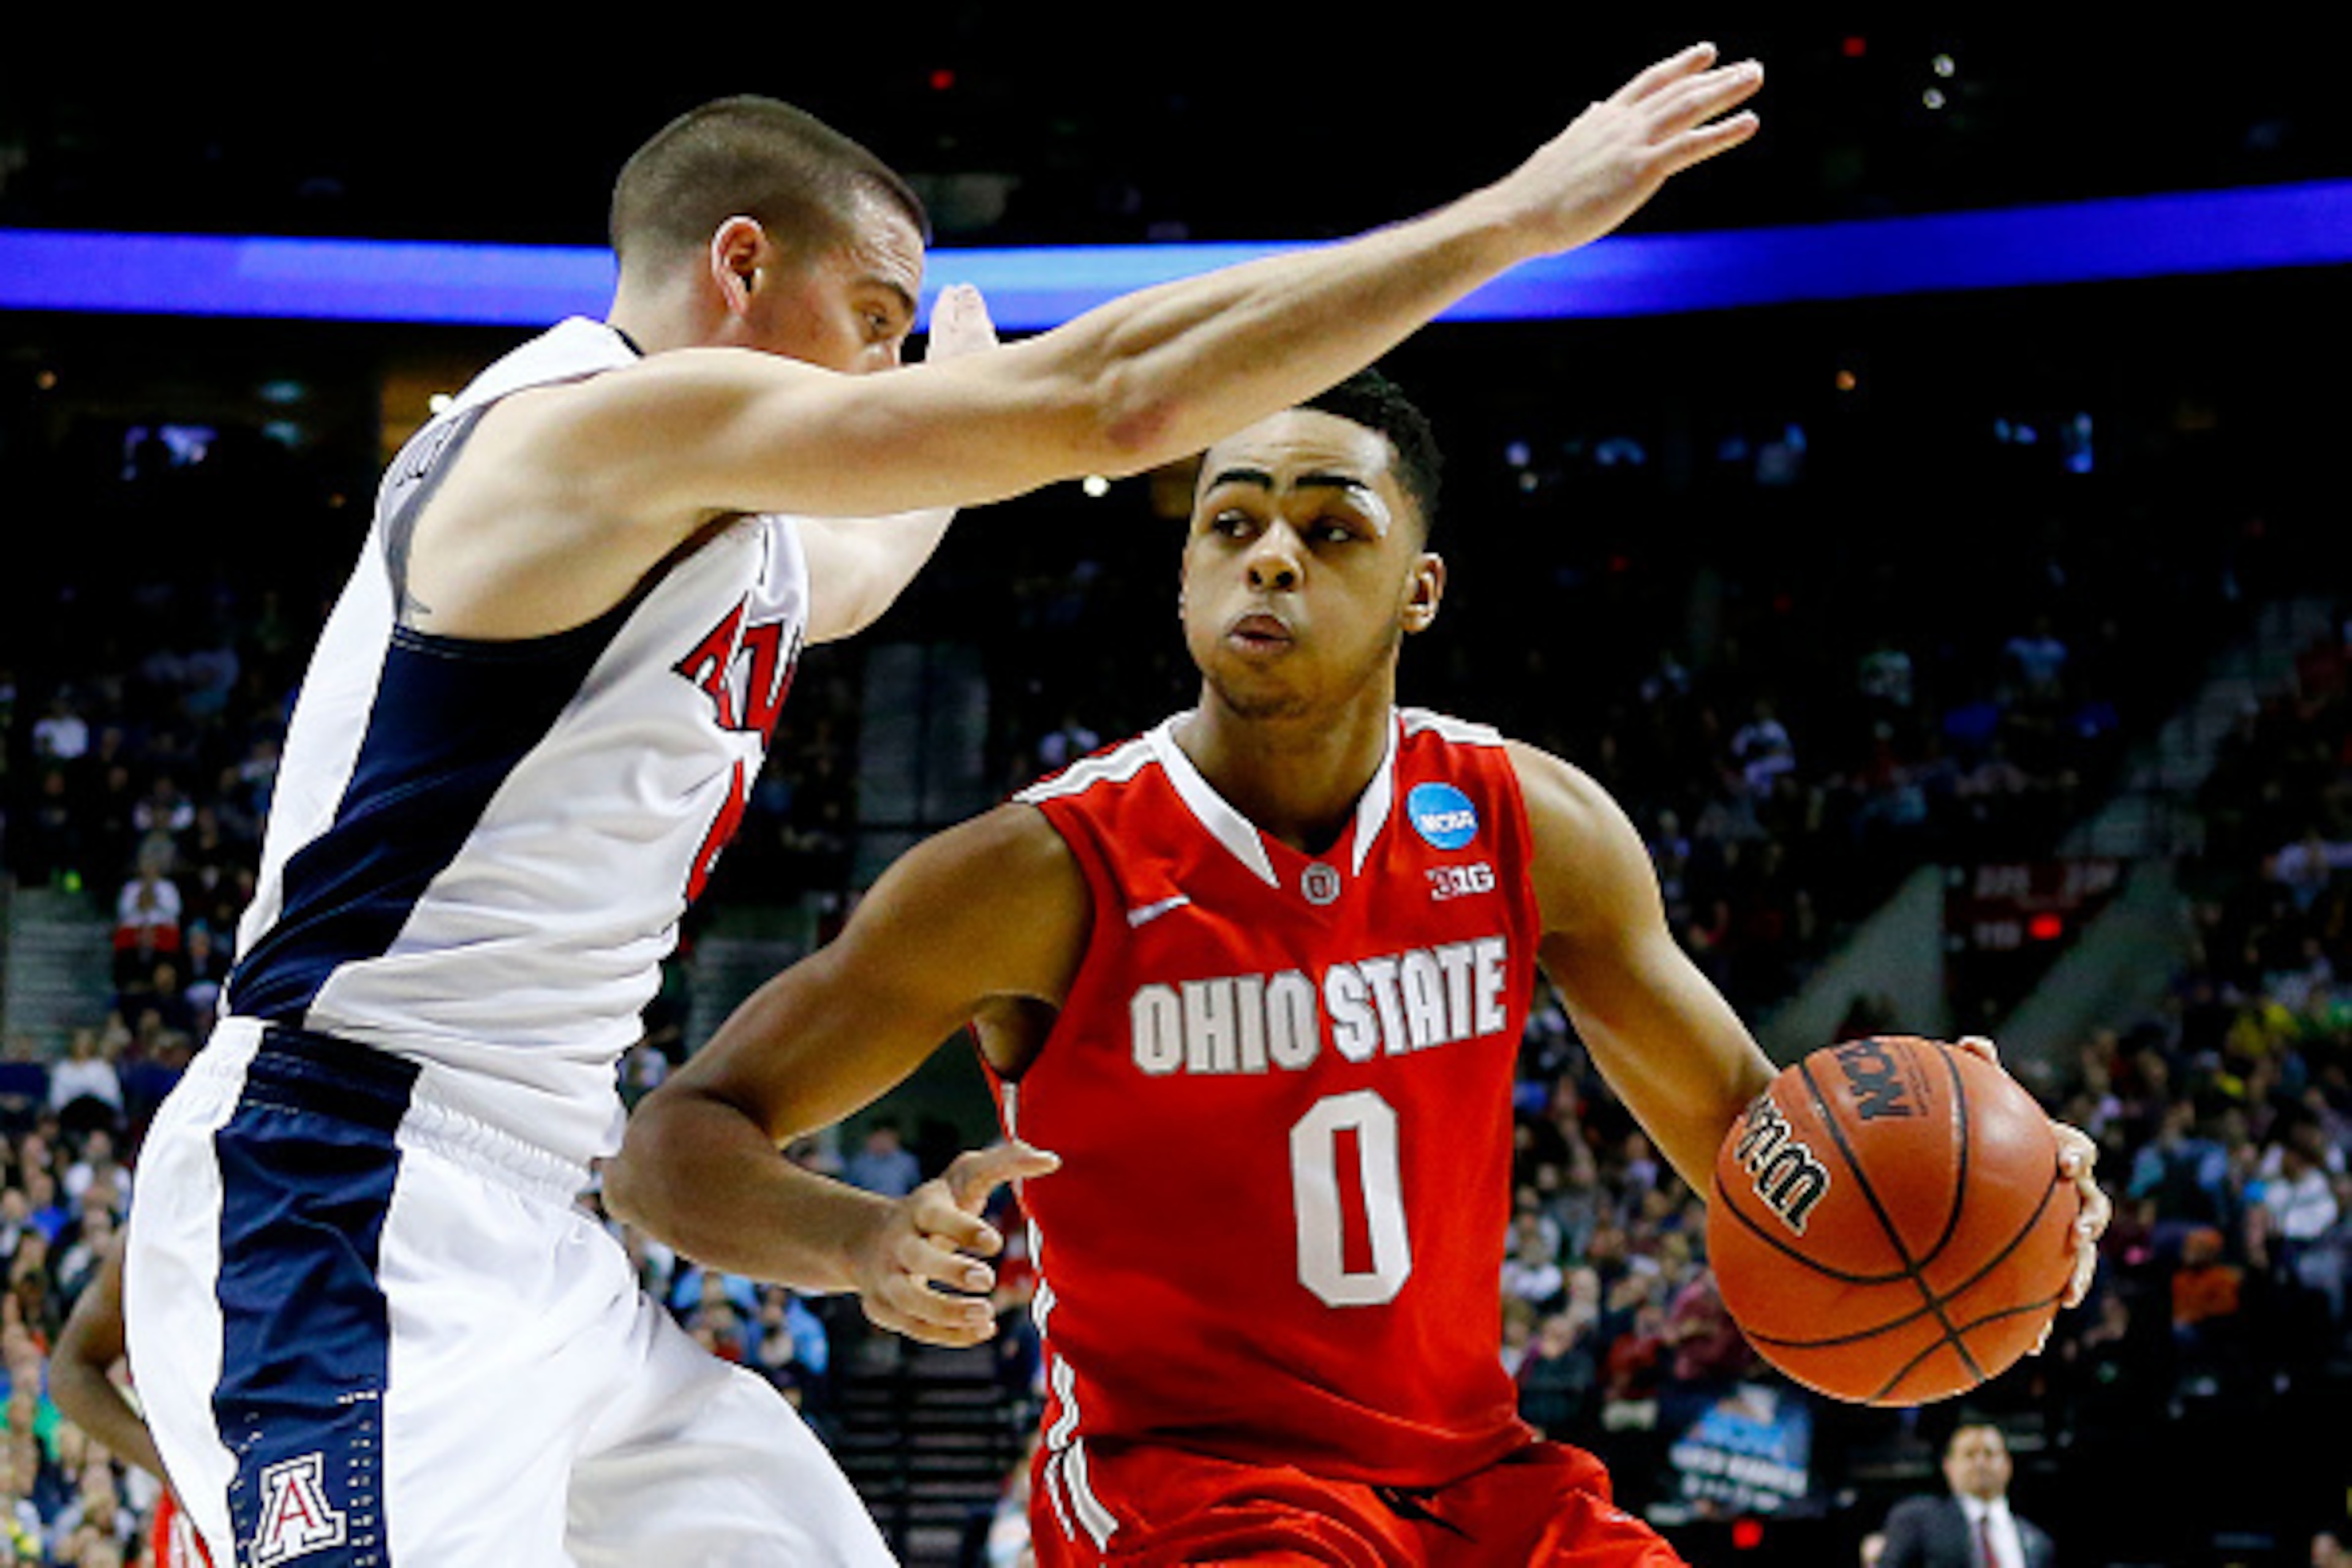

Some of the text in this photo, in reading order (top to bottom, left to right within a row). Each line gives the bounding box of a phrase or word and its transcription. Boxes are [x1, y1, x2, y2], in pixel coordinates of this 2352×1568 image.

[1130, 935, 1507, 1076] OHIO STATE
[1289, 1088, 1412, 1308] 0
[249, 1450, 347, 1567] A
